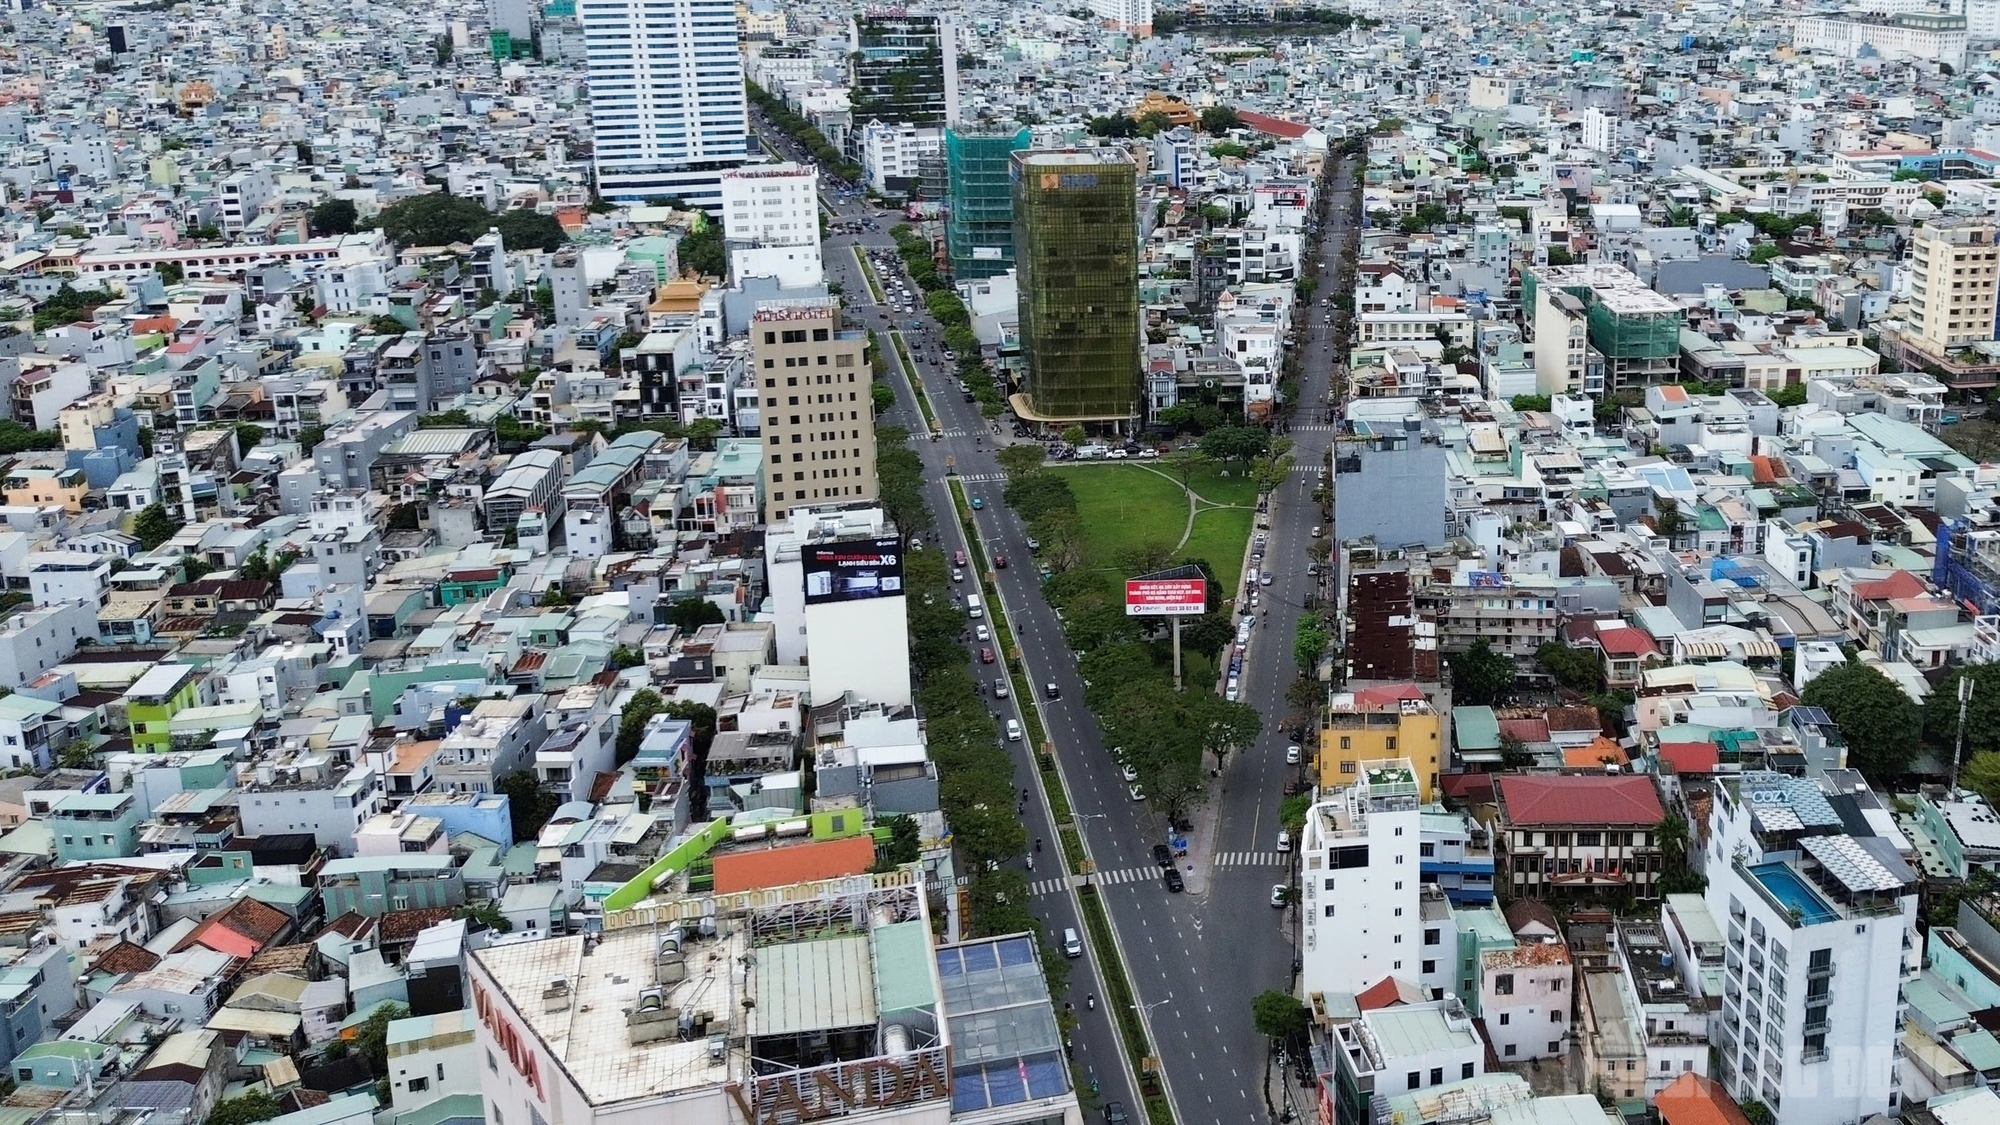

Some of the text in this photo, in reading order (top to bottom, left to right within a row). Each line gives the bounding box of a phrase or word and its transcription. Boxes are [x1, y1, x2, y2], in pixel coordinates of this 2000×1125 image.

[880, 555, 897, 566] X6
[1752, 789, 1793, 803] COZY
[469, 972, 546, 1103] VANDA
[724, 1054, 950, 1125] VANDA
